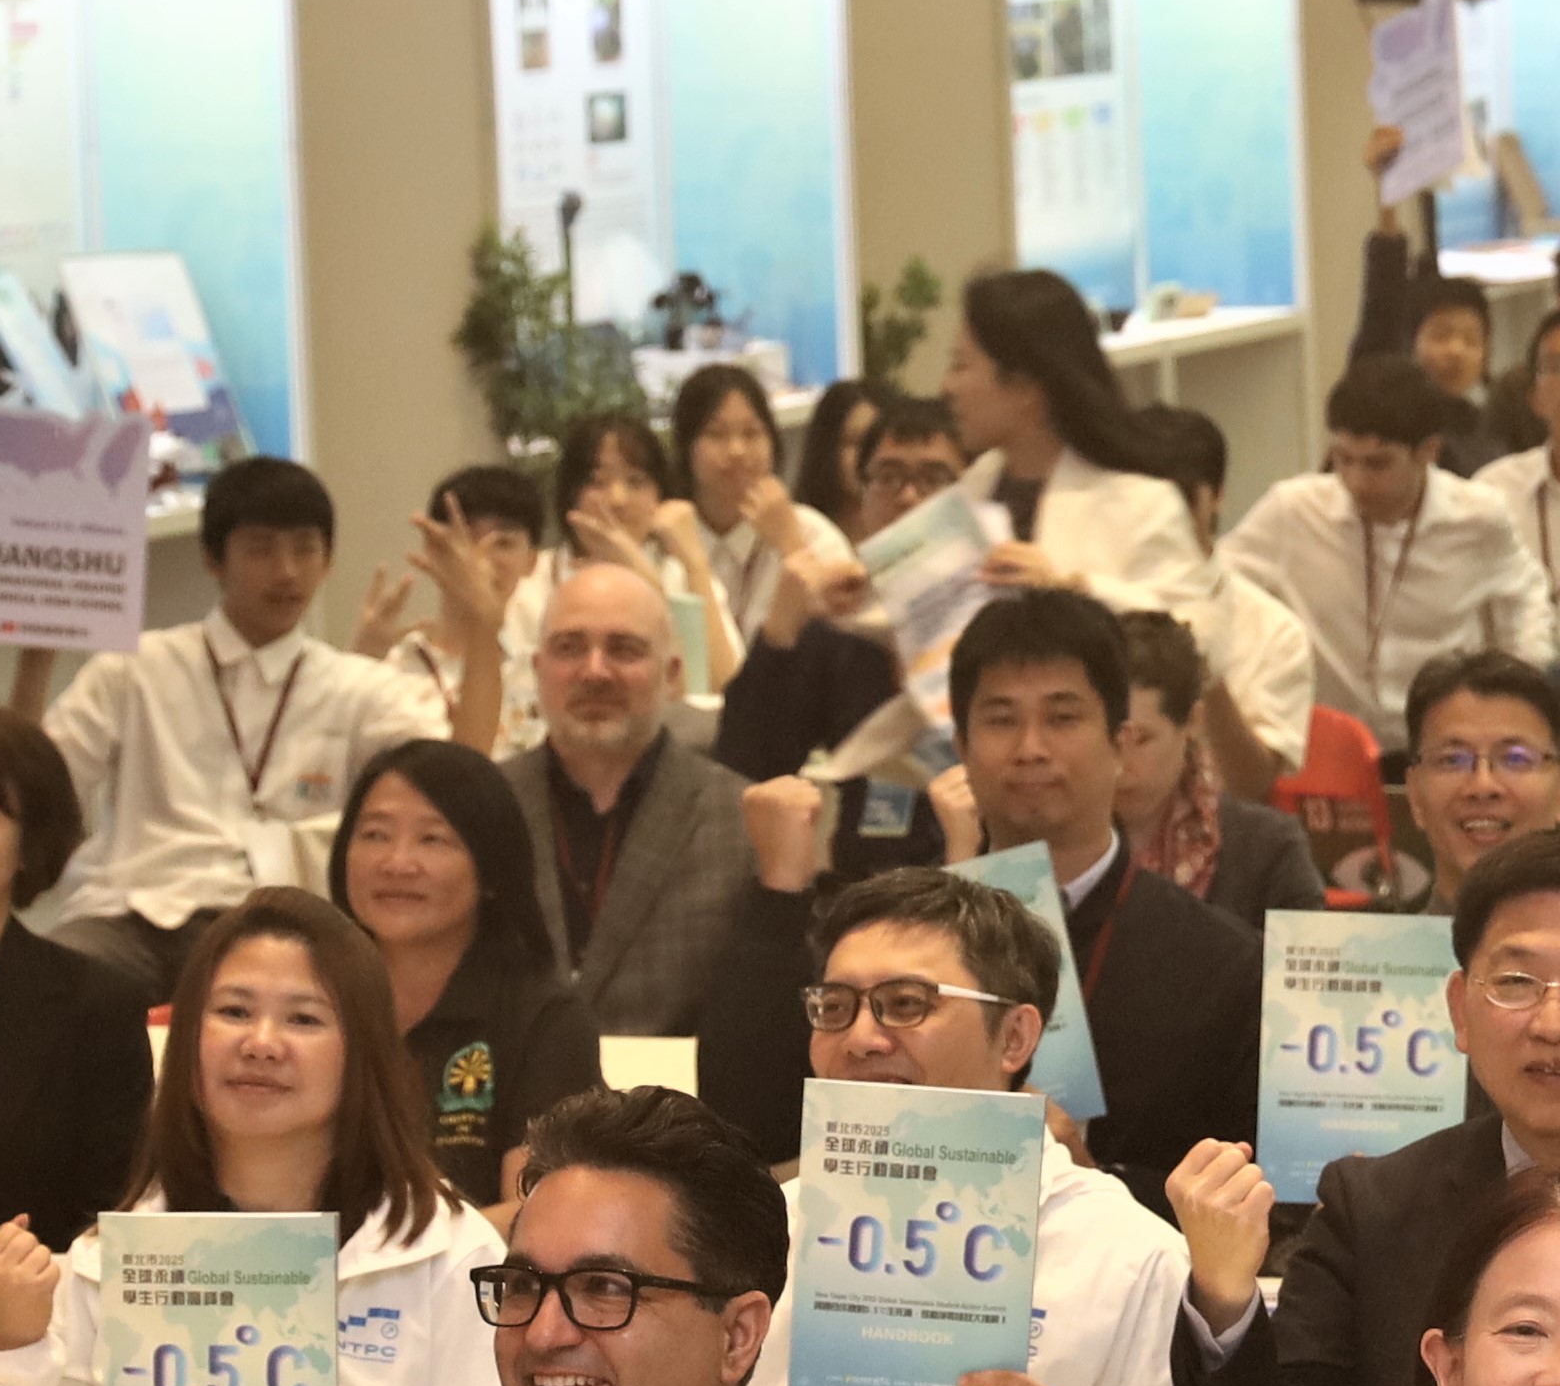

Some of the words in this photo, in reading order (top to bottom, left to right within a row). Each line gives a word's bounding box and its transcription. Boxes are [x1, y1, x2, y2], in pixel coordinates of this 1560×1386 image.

[1280, 1009, 1441, 1077] -0.5°C
[824, 1136, 889, 1157] 全球永續
[891, 1142, 934, 1159] Global
[938, 1145, 1016, 1166] Sustainable
[818, 1200, 1008, 1283] -0.5°C
[122, 1268, 185, 1285] 全球永續
[187, 1270, 230, 1286] Global
[233, 1269, 311, 1286] Sustainable
[861, 1326, 954, 1345] HANDBOOK
